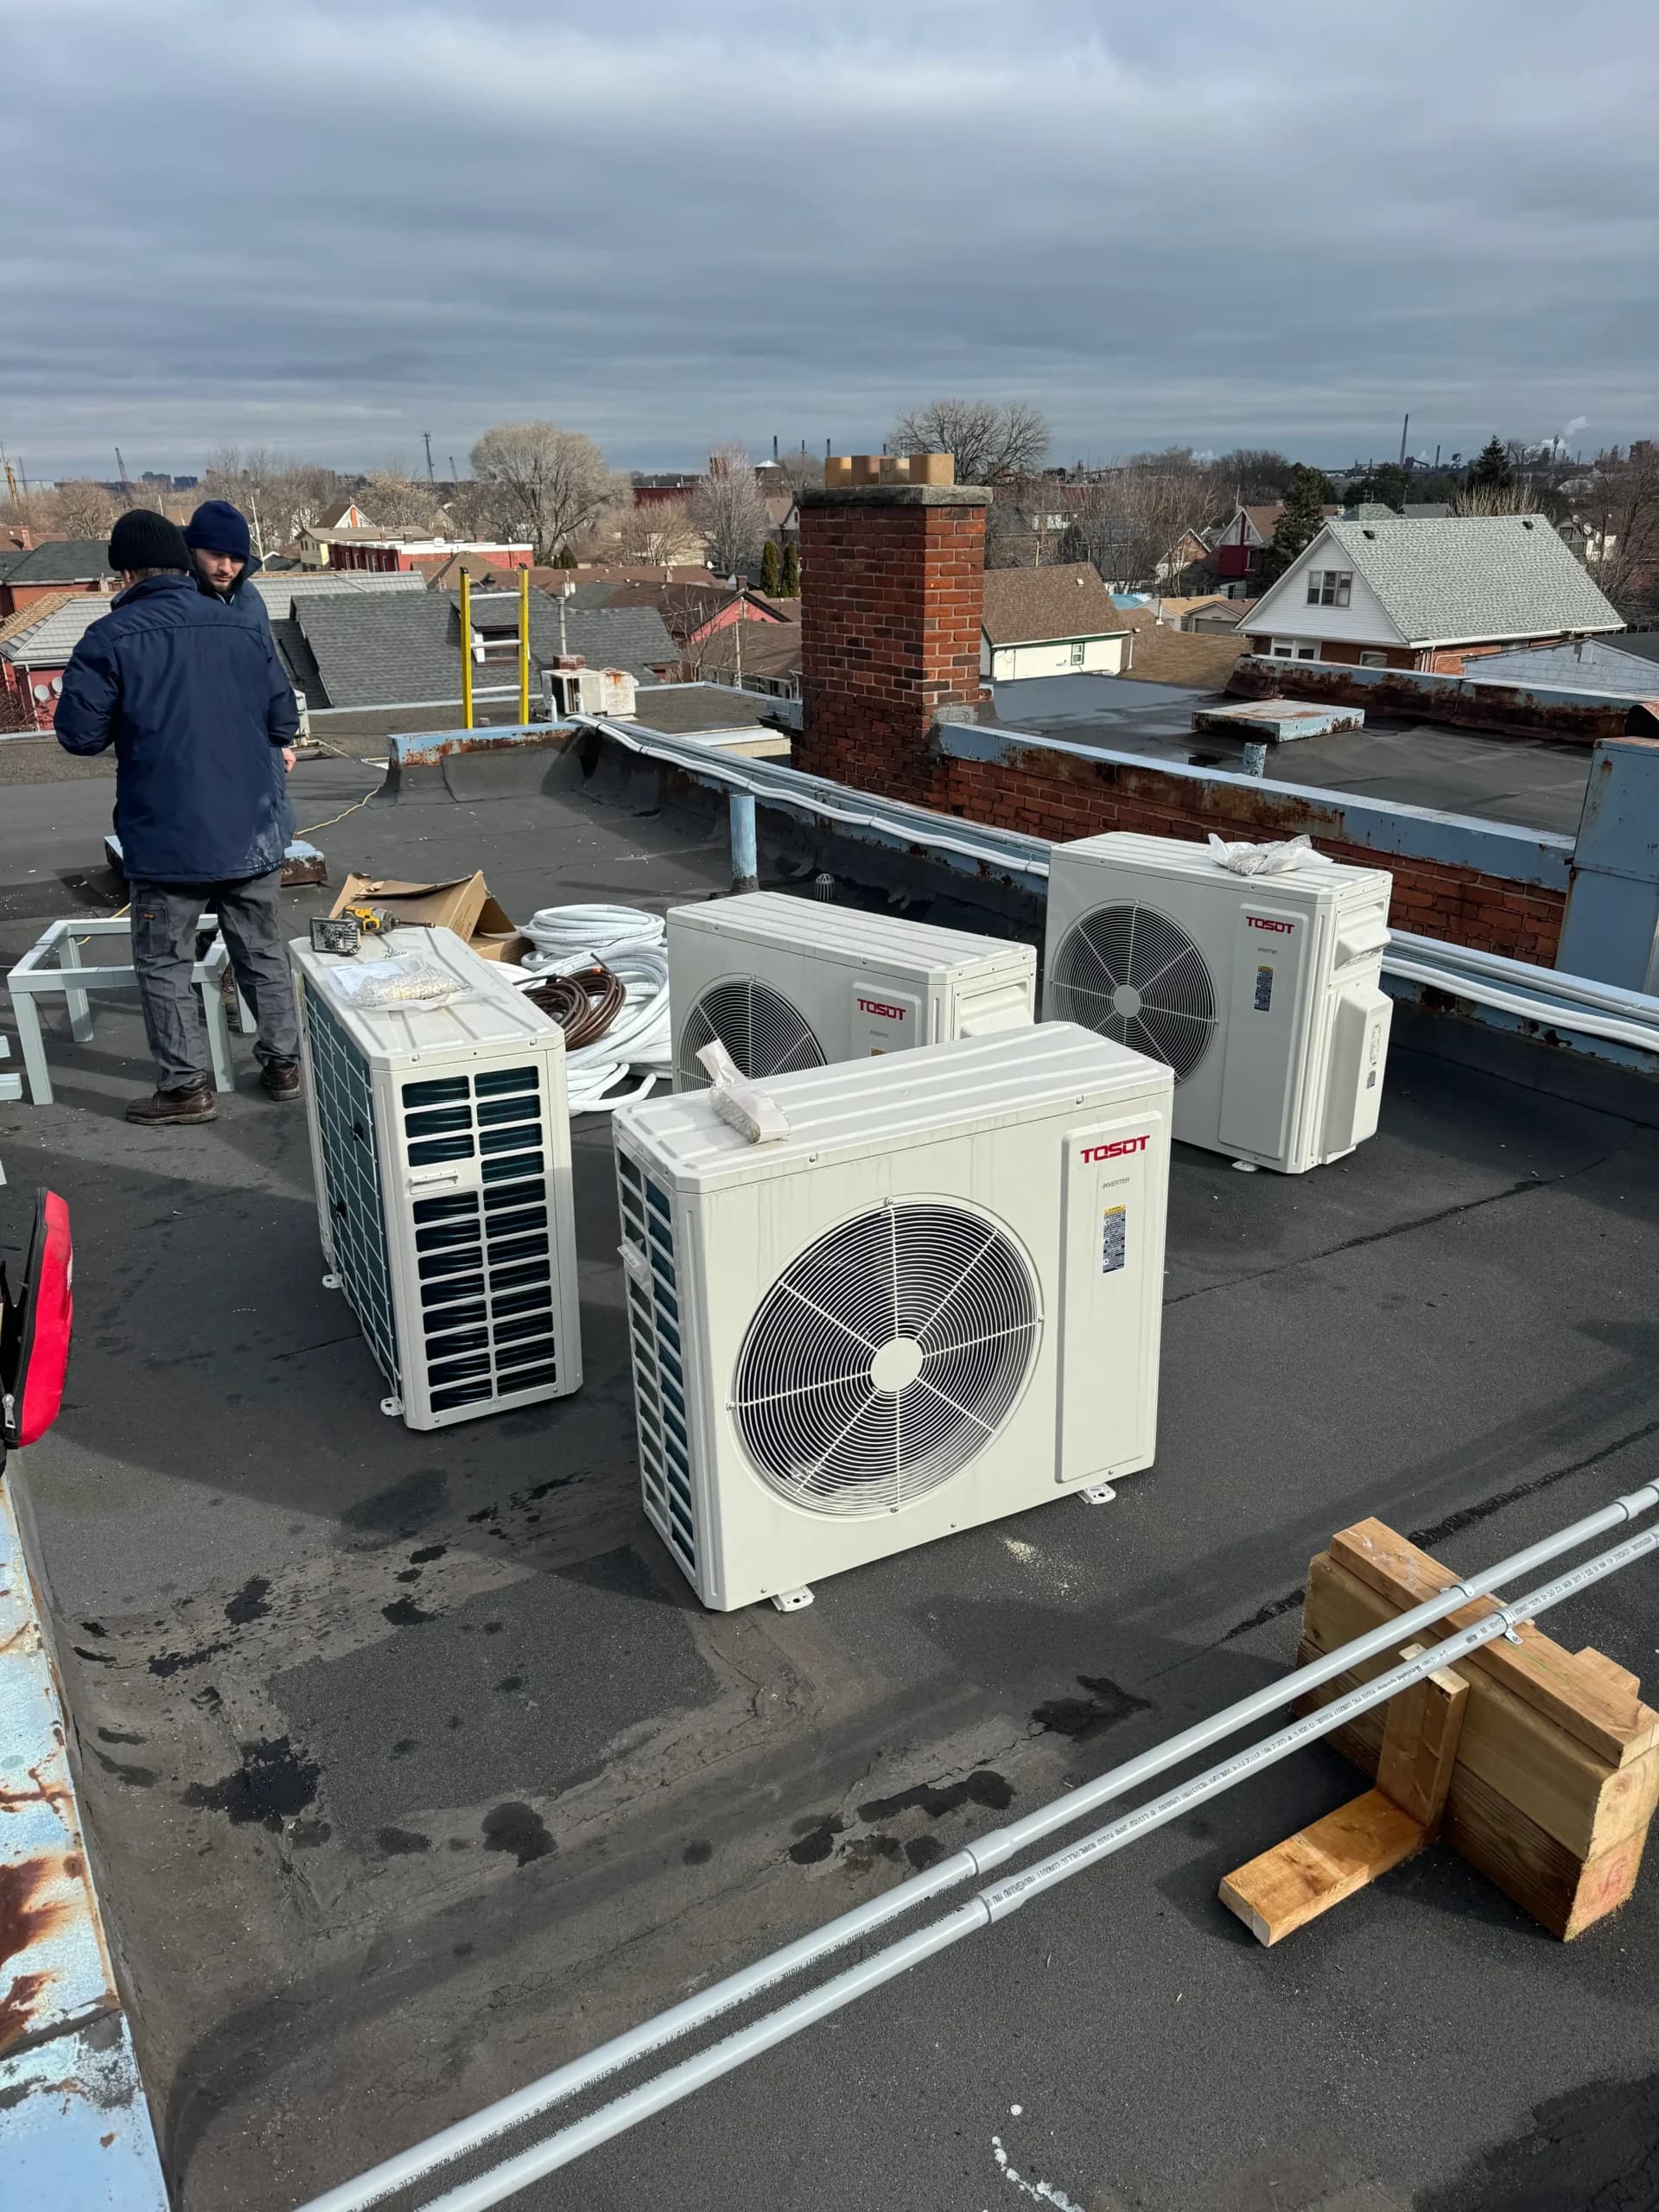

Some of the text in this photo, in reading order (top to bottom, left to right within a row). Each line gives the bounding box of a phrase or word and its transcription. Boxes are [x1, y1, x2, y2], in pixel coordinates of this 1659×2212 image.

[1246, 916, 1294, 934] TOSOT
[857, 998, 906, 1020] TOSOT
[1080, 1135, 1150, 1164] TOSOT
[1102, 1176, 1131, 1190] INVERTER
